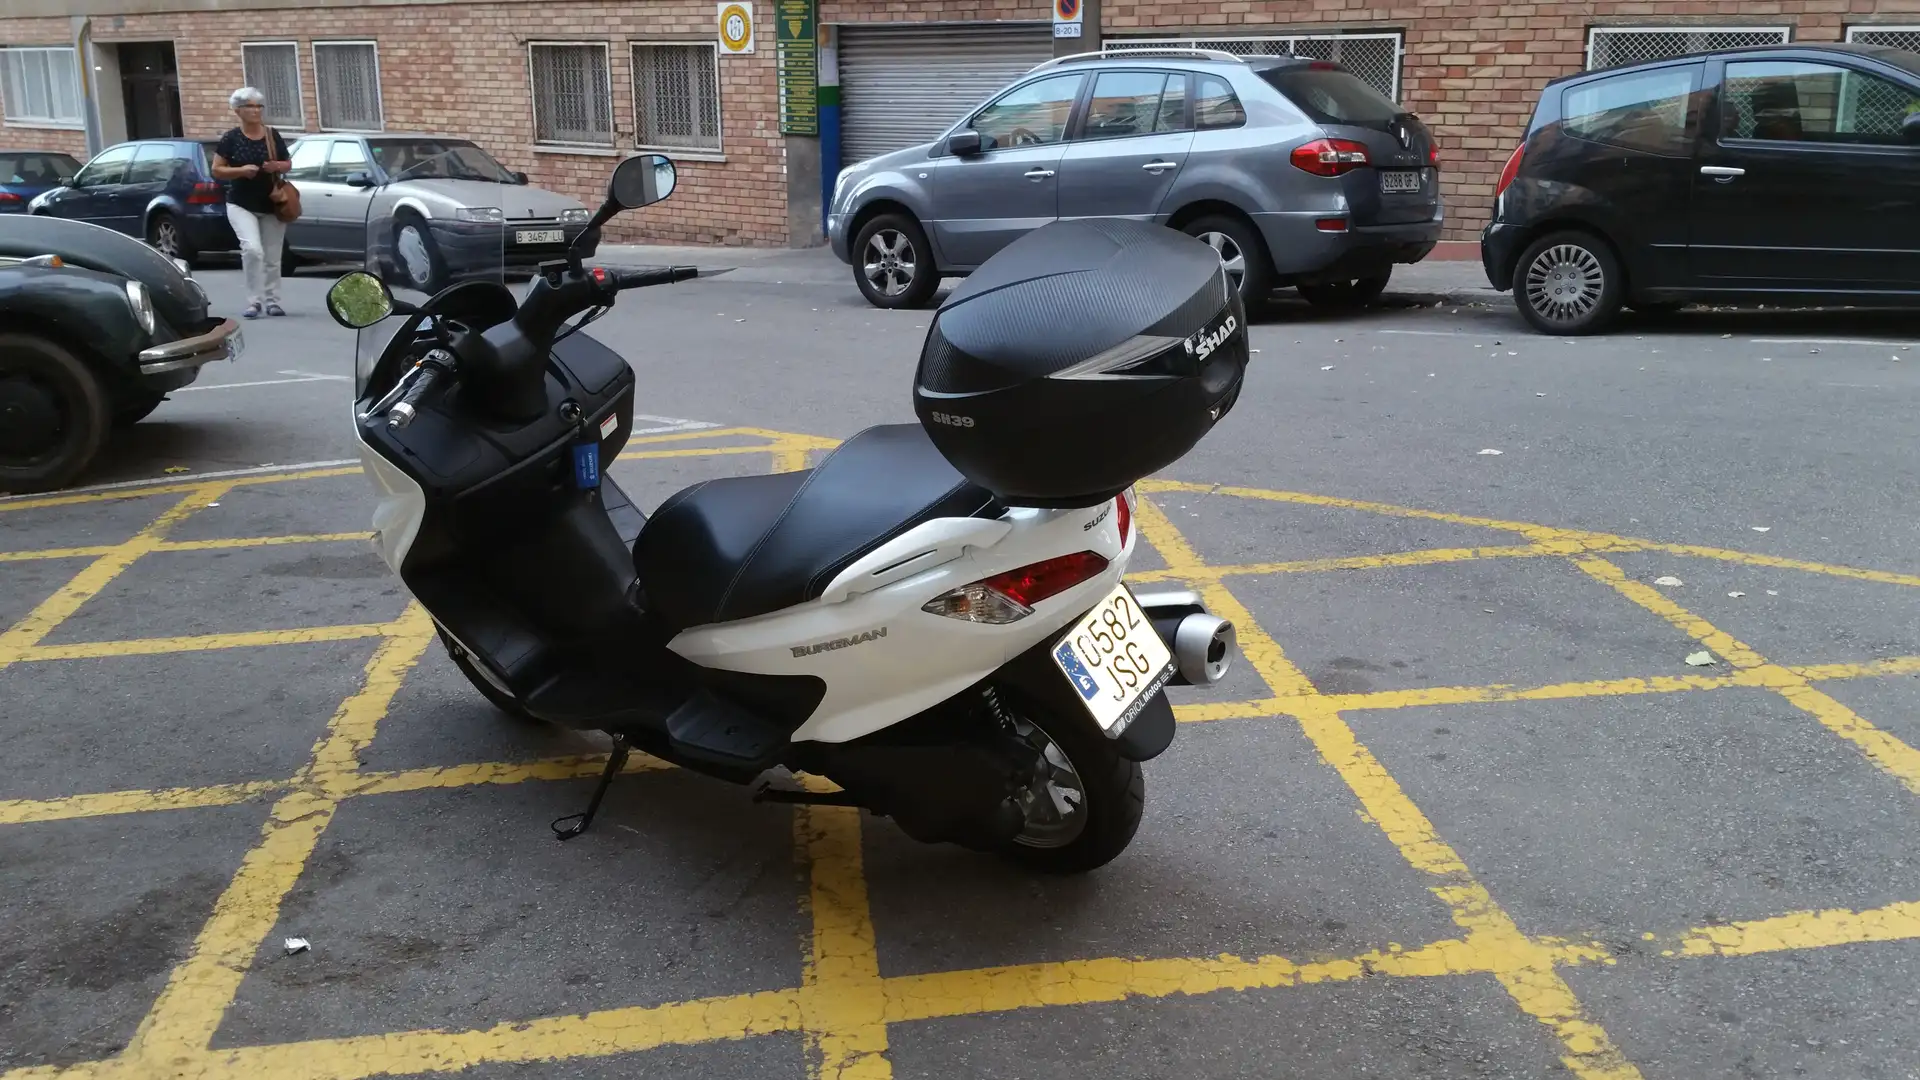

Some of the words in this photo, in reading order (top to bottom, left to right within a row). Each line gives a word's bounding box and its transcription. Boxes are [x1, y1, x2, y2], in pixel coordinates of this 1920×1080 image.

[1404, 174, 1418, 187] GFJ
[518, 233, 523, 242] B
[528, 232, 548, 242] 3467
[553, 231, 563, 241] LU
[1195, 315, 1237, 361] SHAD
[932, 411, 975, 428] SH39
[789, 626, 888, 658] BURGMAN
[1077, 595, 1140, 667] 0582
[1106, 641, 1150, 702] JSG
[1078, 677, 1092, 691] E
